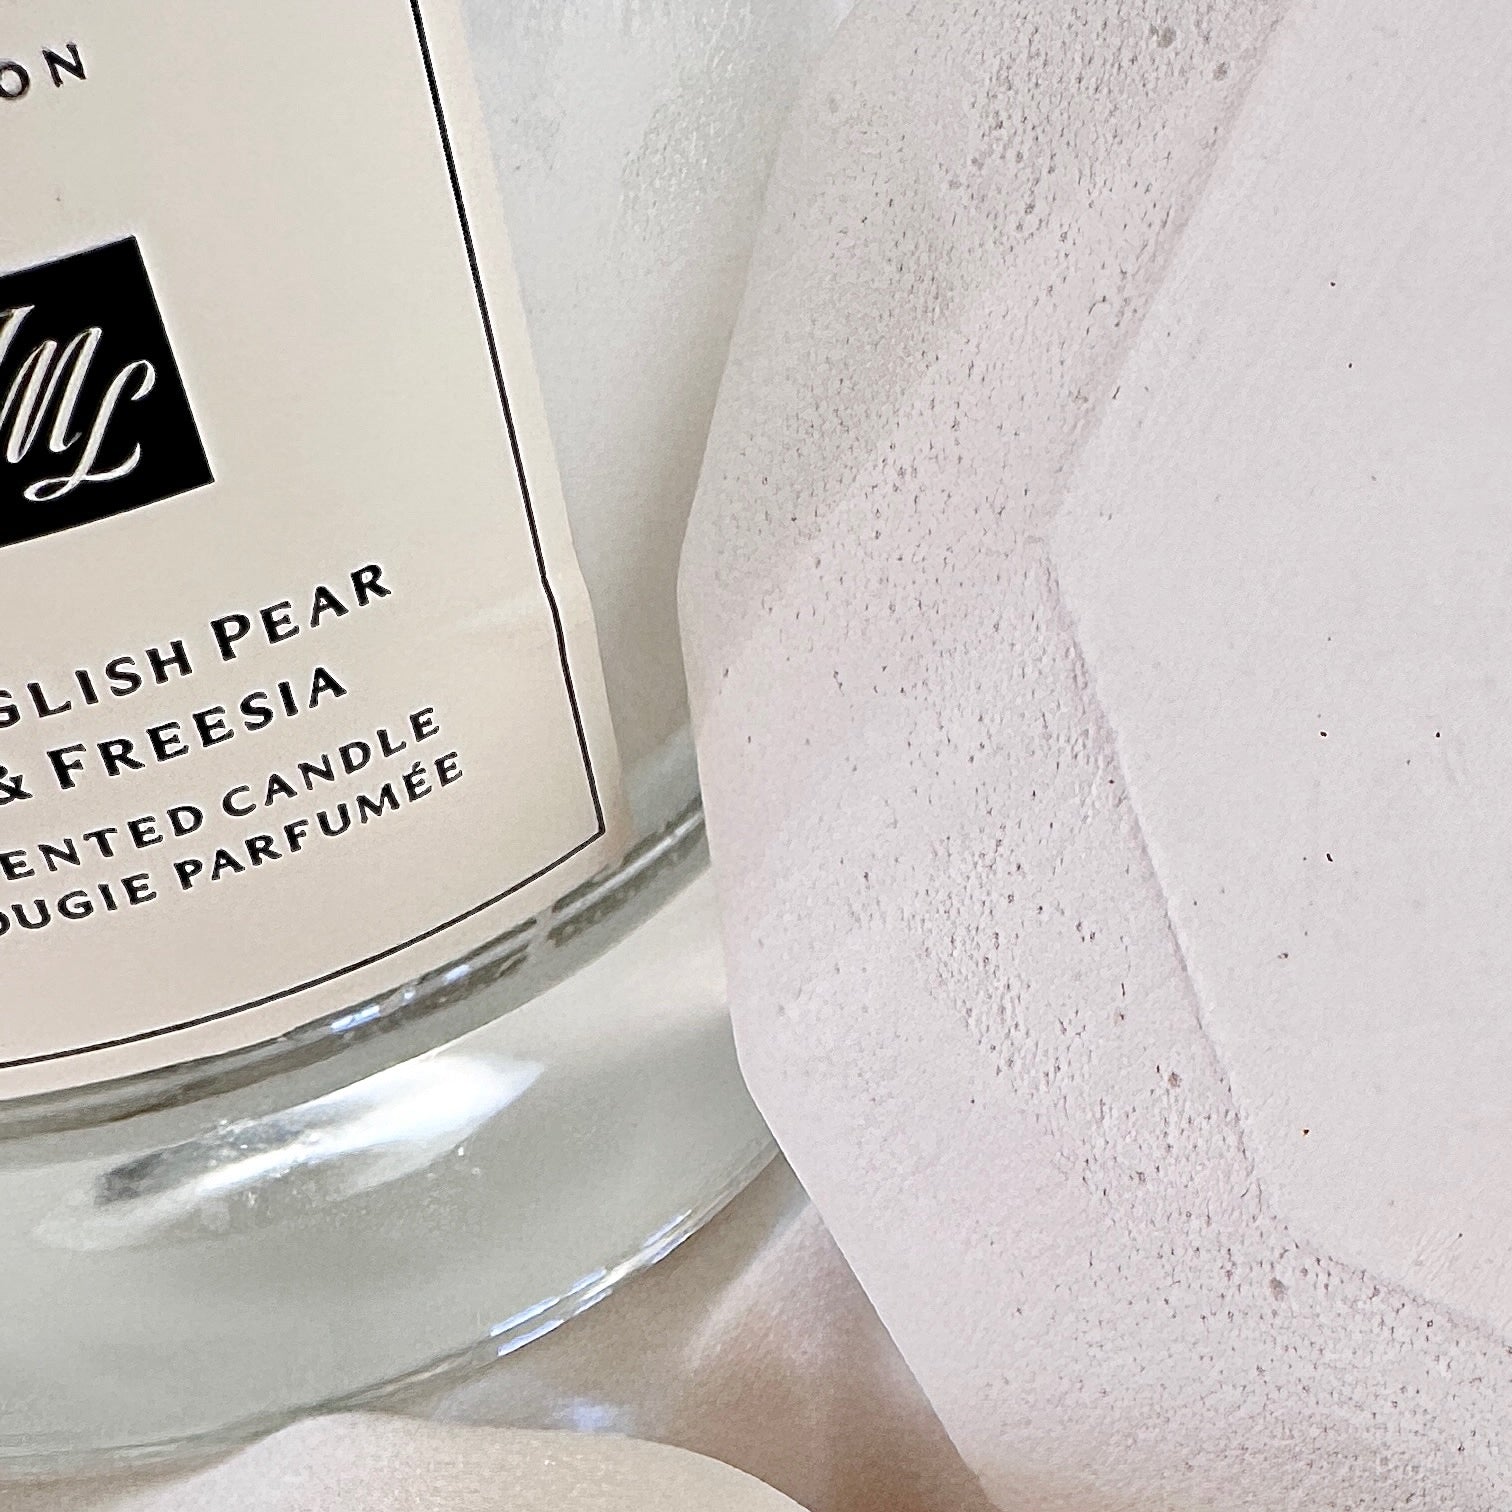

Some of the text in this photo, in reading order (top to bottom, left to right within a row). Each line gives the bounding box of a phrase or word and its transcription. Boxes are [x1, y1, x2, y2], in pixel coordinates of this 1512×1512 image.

[0, 42, 87, 101] ON
[210, 564, 392, 661] PEAR
[0, 667, 347, 806] & FREESIA
[0, 707, 440, 881] ENTED CANDLE
[173, 751, 463, 891] PARFUMÉE
